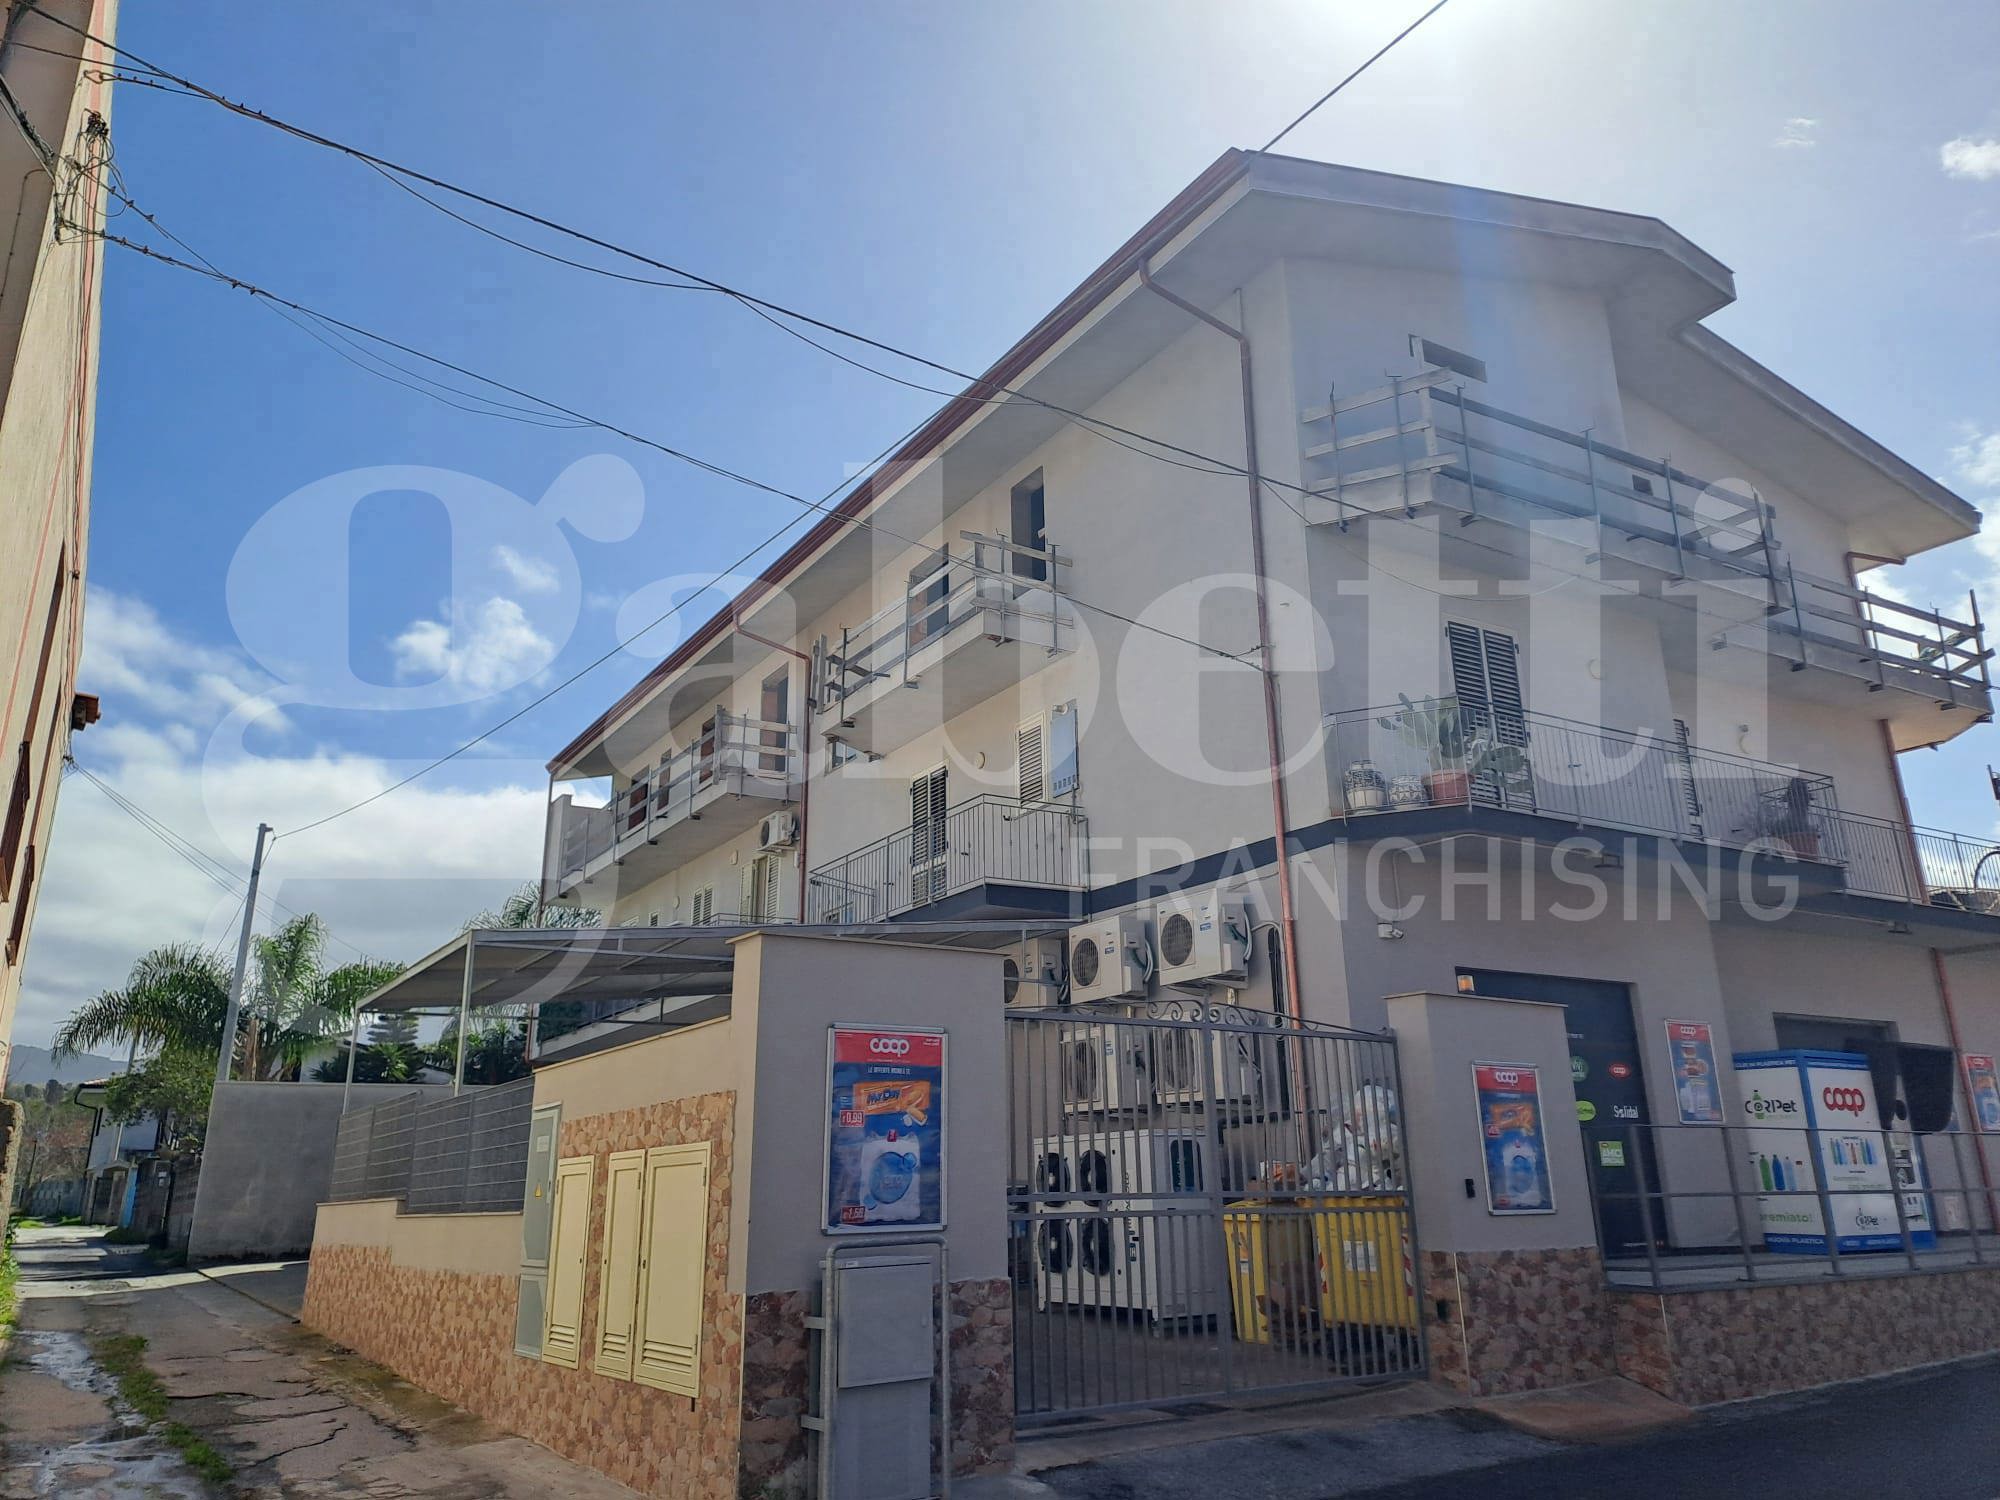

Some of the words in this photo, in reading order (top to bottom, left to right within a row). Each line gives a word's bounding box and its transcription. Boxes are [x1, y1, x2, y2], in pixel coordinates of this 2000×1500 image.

[869, 1037, 910, 1057] coop
[1495, 1071, 1519, 1087] coop
[1823, 1086, 1866, 1118] coop
